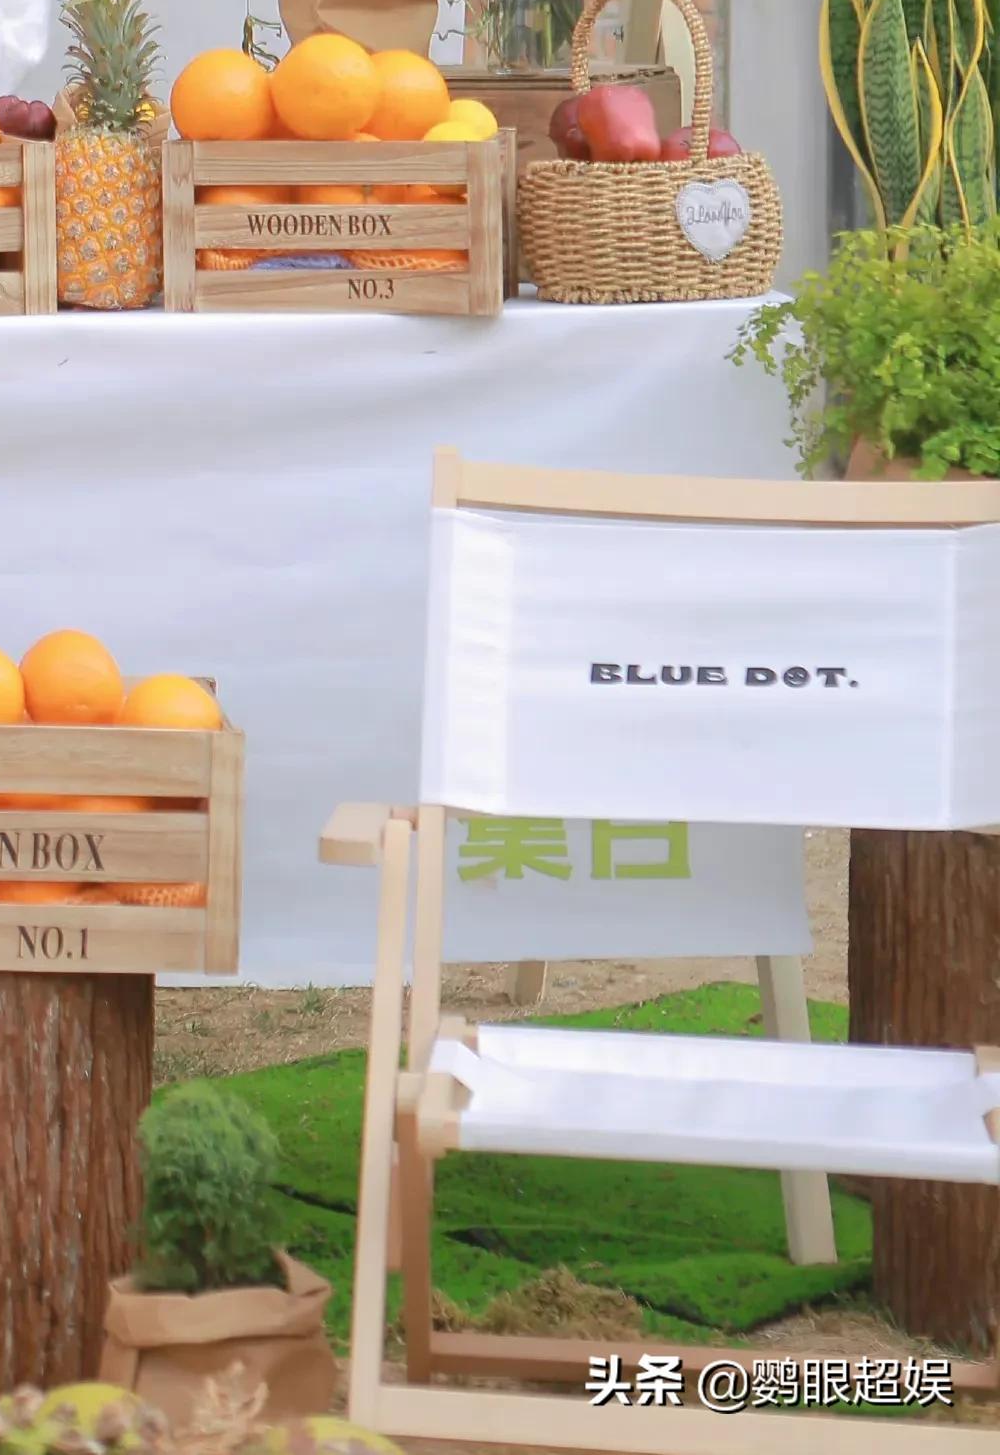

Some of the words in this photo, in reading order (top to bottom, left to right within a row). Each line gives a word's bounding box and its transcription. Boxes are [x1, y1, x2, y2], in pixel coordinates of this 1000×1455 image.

[247, 214, 346, 237] WOODEN
[348, 214, 393, 236] BOX
[347, 278, 395, 301] NO.3
[589, 662, 728, 686] BLUE
[31, 831, 106, 872] BOX
[16, 925, 89, 960] NO.1
